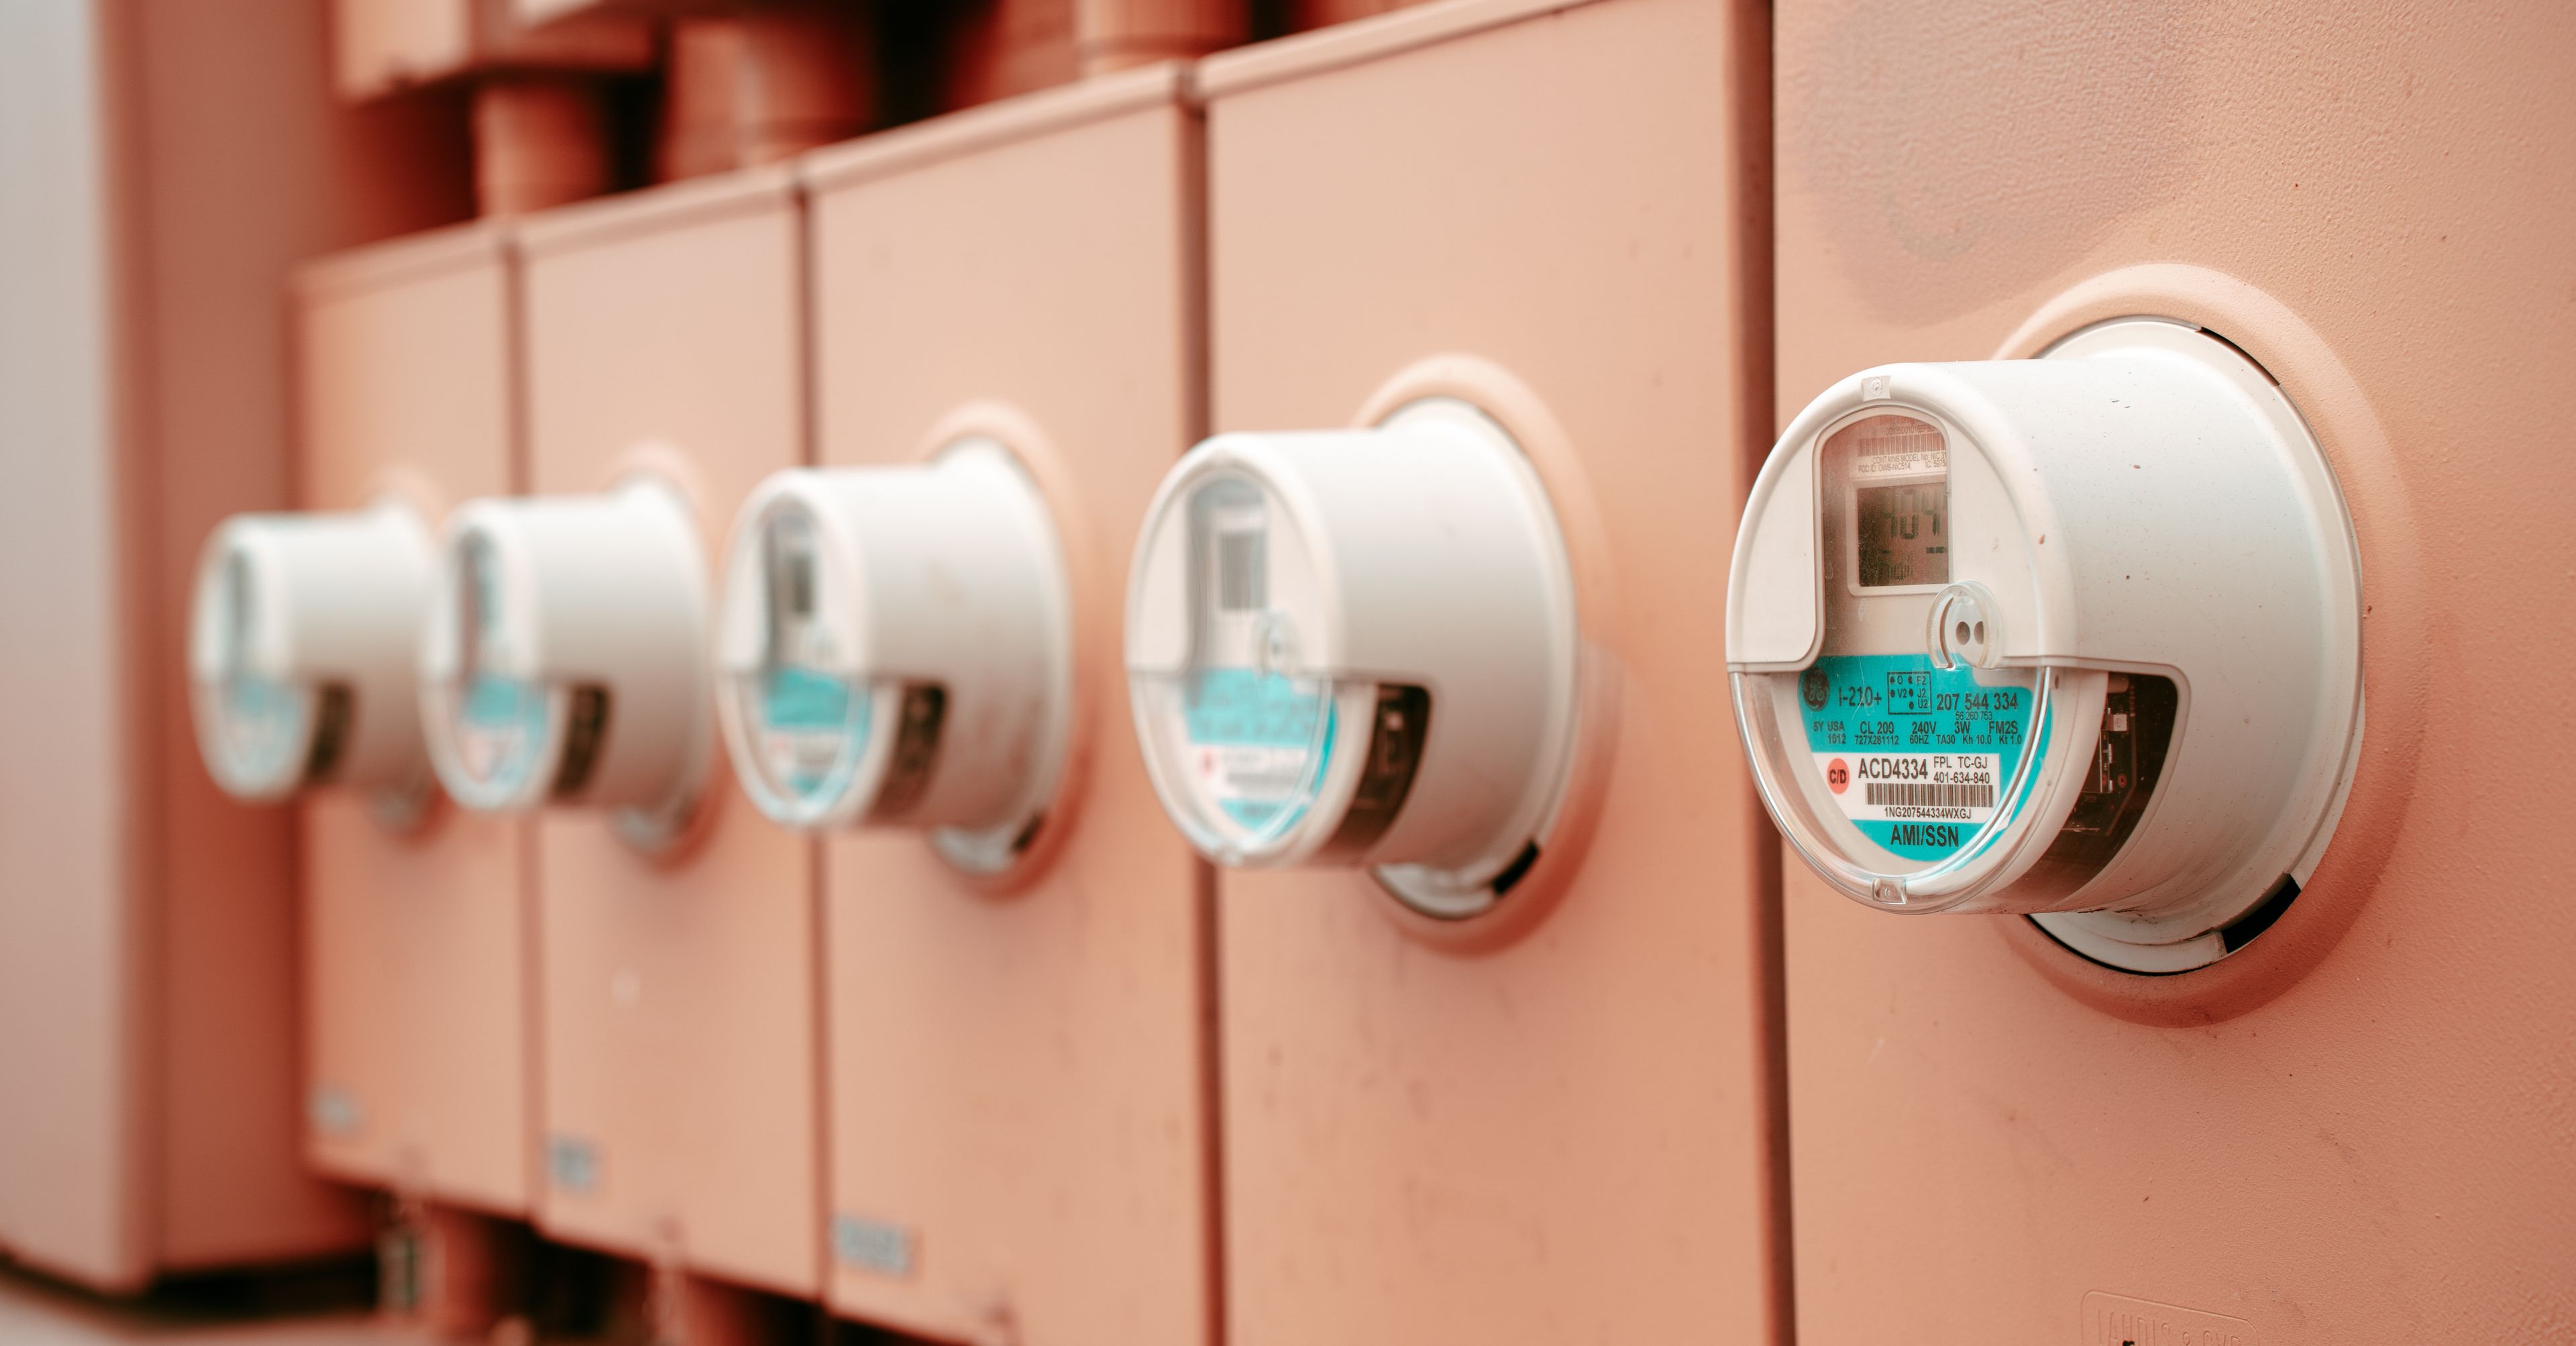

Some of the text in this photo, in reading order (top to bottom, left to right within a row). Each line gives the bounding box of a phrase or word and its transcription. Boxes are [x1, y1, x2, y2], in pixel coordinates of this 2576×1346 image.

[1872, 455, 1900, 464] CONTAINS
[1900, 453, 1920, 462] MODEL
[1858, 464, 1870, 472] FCC
[1917, 676, 1927, 686] F2
[1837, 686, 1882, 707] I-210+
[1896, 688, 1927, 698] V2 J2
[1917, 698, 1928, 709] U2
[1936, 692, 2019, 711] 207 544 334
[1955, 711, 1992, 721] 56 260 753
[1827, 720, 1845, 731] USA
[1859, 721, 1874, 735] CL
[1876, 721, 1894, 735] 200
[1911, 721, 1937, 735] 240V
[1954, 721, 1971, 735] 3W
[1988, 720, 2019, 735] FM2S
[1909, 734, 1929, 745] 60HZ
[1936, 734, 1955, 745] TA30
[1962, 734, 1974, 745] Kh
[1976, 734, 1992, 745] 10.0
[2010, 734, 2022, 745] 1.0
[1829, 756, 1988, 784] C/D ACD4334 FPL TC-GJ
[1933, 772, 1990, 784] 401-634-840
[1884, 806, 1972, 820] 1NG207544334WXGJ
[1890, 824, 1960, 847] AMI/SSN
